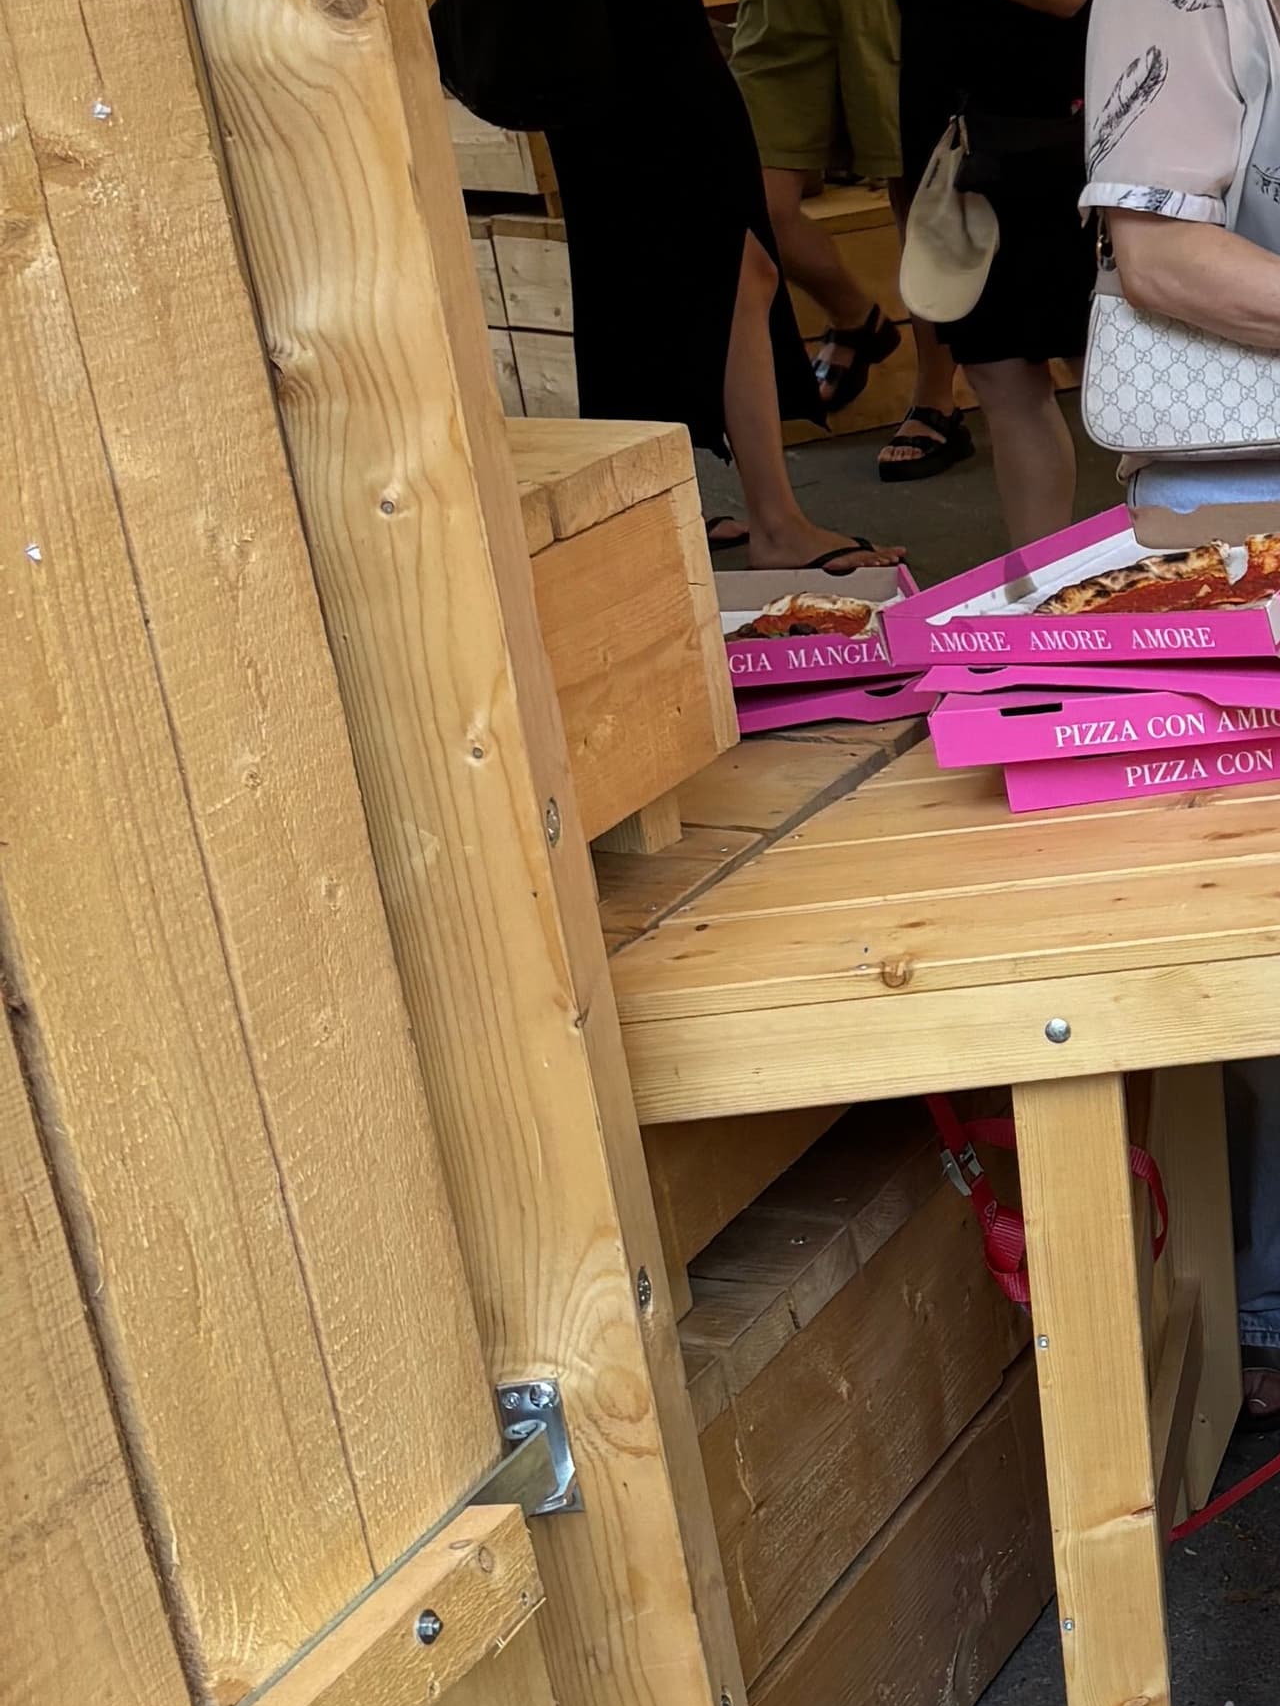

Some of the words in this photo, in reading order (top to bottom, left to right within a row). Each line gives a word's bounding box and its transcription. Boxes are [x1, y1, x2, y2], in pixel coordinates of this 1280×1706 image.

[786, 640, 888, 671] MANGIA
[929, 630, 1012, 654] AMORE
[1029, 628, 1112, 652] AMORE
[1130, 626, 1217, 650] AMORE
[1054, 718, 1139, 749] PIZZA
[1147, 711, 1207, 740] CON
[1124, 758, 1210, 788] PIZZA
[1216, 748, 1275, 777] CON
